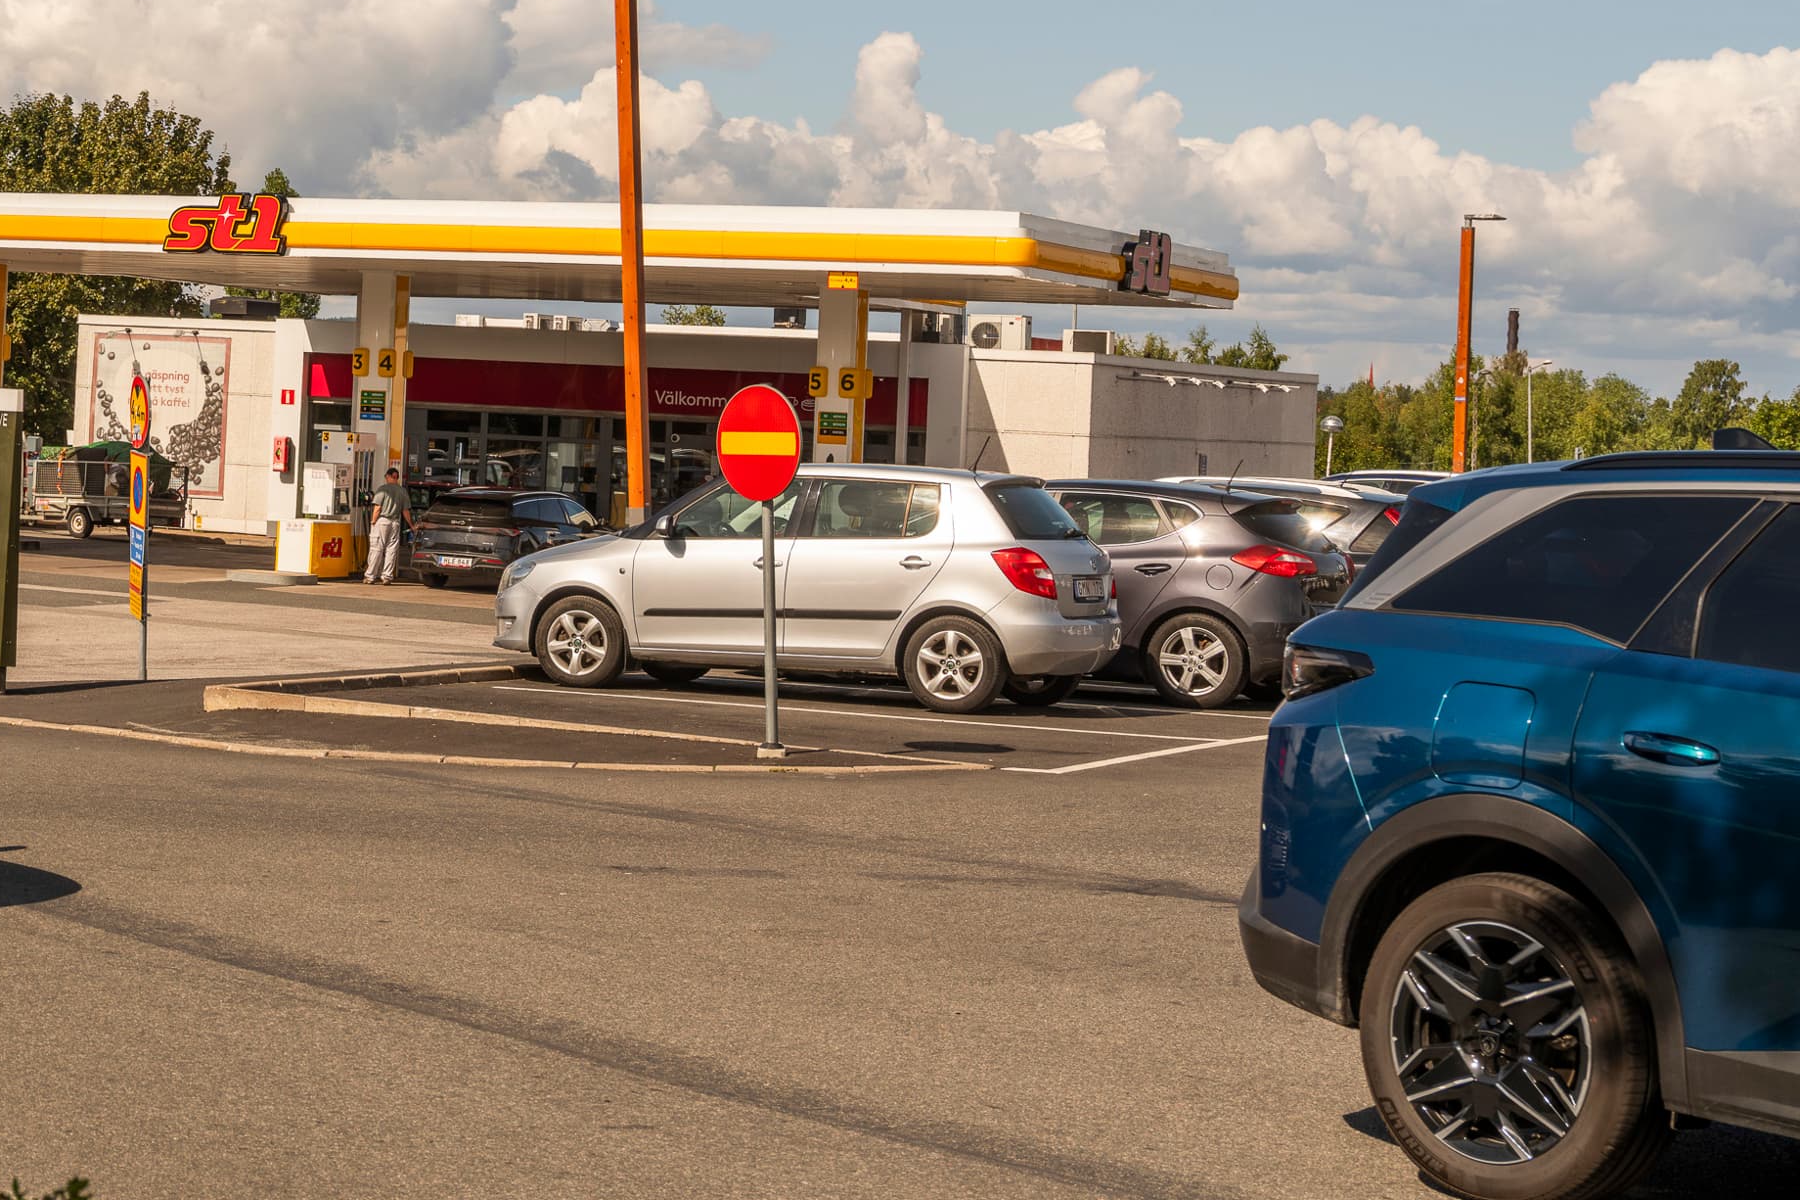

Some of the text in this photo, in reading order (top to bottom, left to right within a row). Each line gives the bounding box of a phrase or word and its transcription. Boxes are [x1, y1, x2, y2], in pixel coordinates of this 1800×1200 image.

[162, 193, 286, 255] st1
[1126, 230, 1171, 296] st1
[353, 354, 363, 370] 3
[379, 355, 393, 371] 4
[145, 369, 190, 384] gäspning
[810, 373, 822, 390] 5
[841, 374, 855, 391] 6
[160, 397, 191, 408] kaffe!
[323, 432, 329, 441] 3
[347, 434, 354, 443] 4
[321, 537, 343, 558] st1
